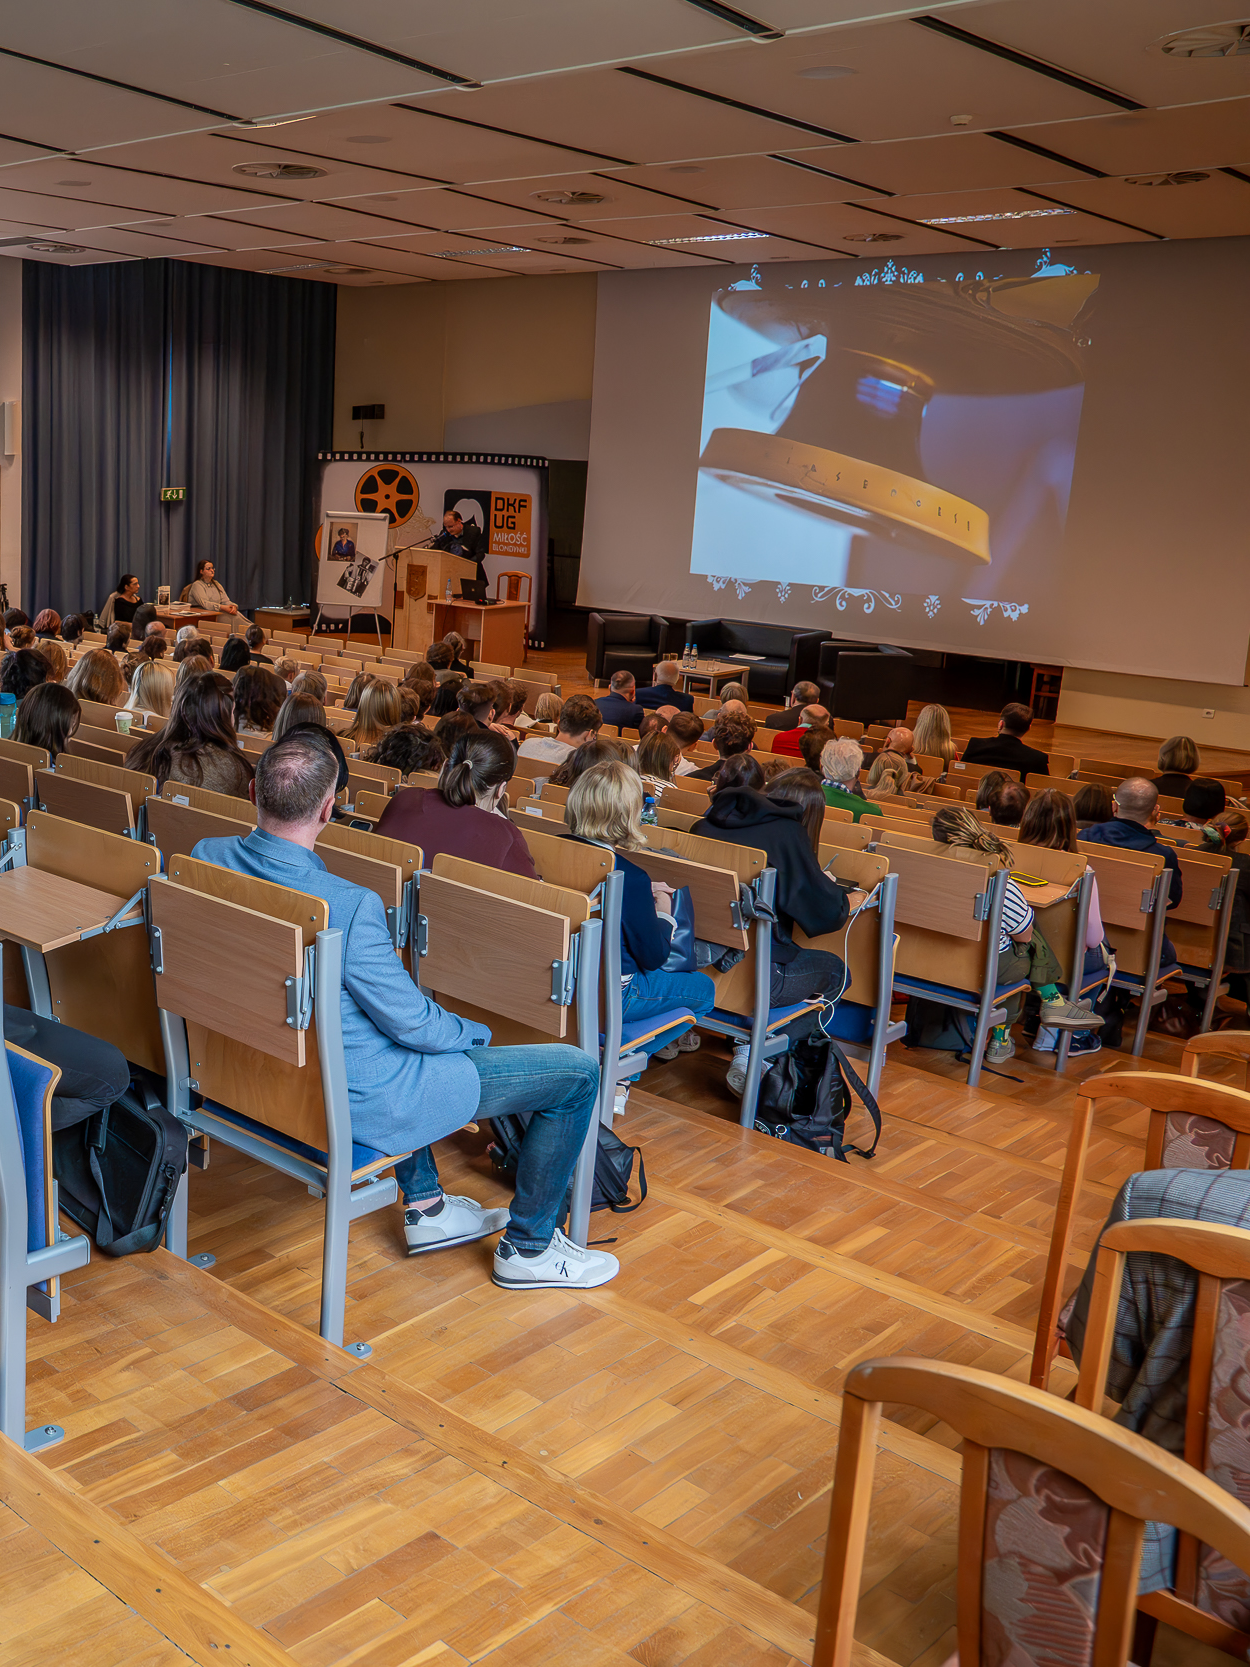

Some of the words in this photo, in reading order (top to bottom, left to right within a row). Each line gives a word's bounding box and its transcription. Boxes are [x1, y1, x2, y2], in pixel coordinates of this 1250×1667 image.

[494, 496, 528, 514] DKF
[493, 513, 516, 531] UG
[492, 532, 528, 545] MIŁOŚĆ
